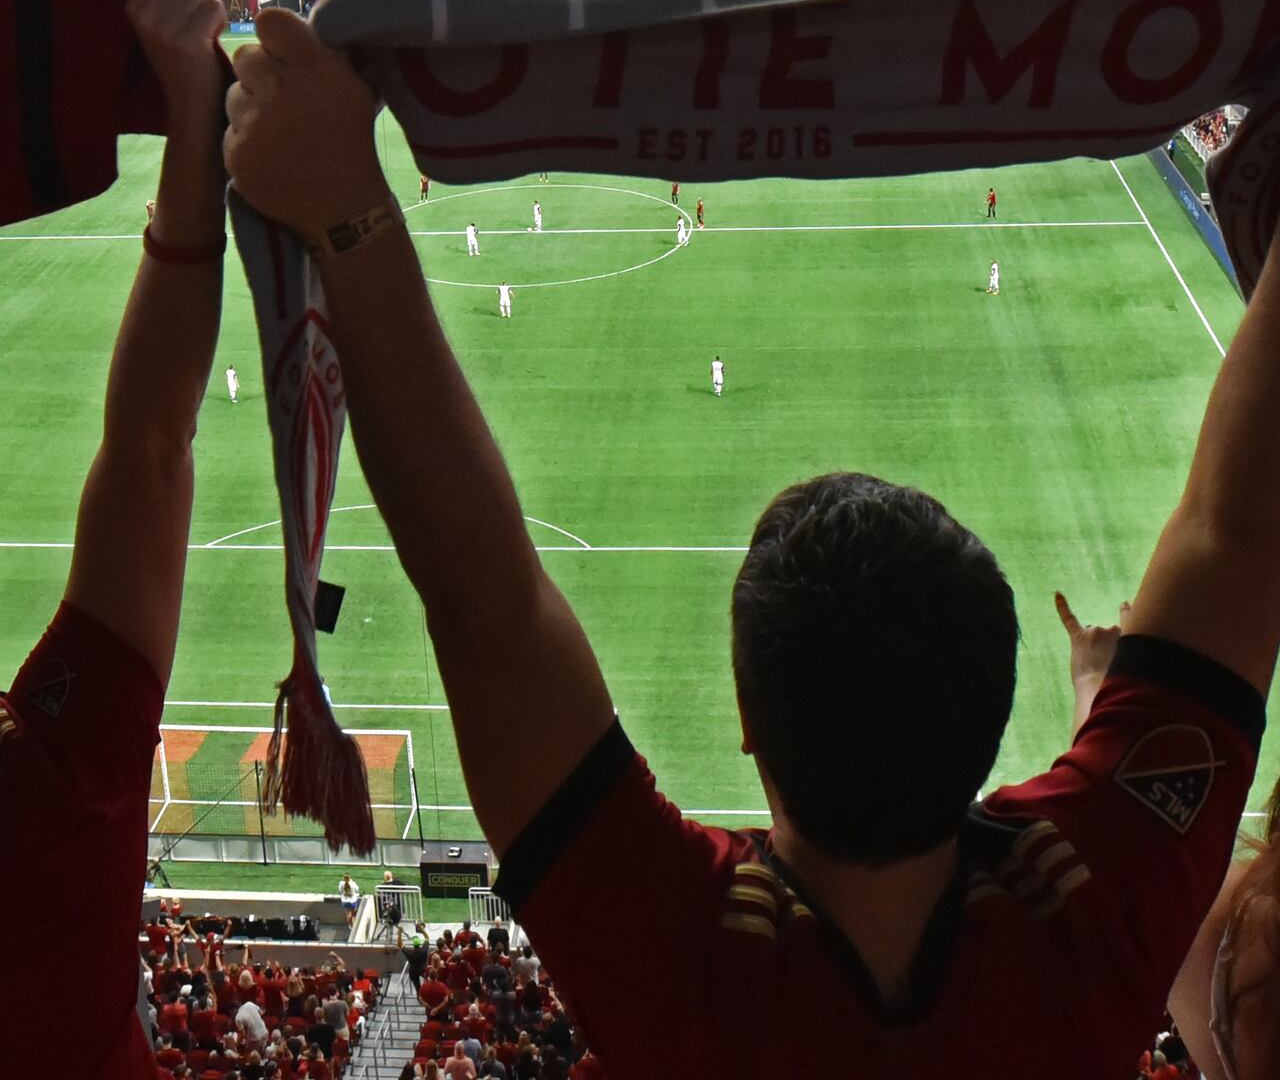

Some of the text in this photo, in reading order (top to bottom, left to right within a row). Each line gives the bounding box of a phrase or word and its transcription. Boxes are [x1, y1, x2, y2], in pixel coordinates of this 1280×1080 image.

[636, 126, 833, 160] EST 2016
[431, 875, 477, 885] CONQUER
